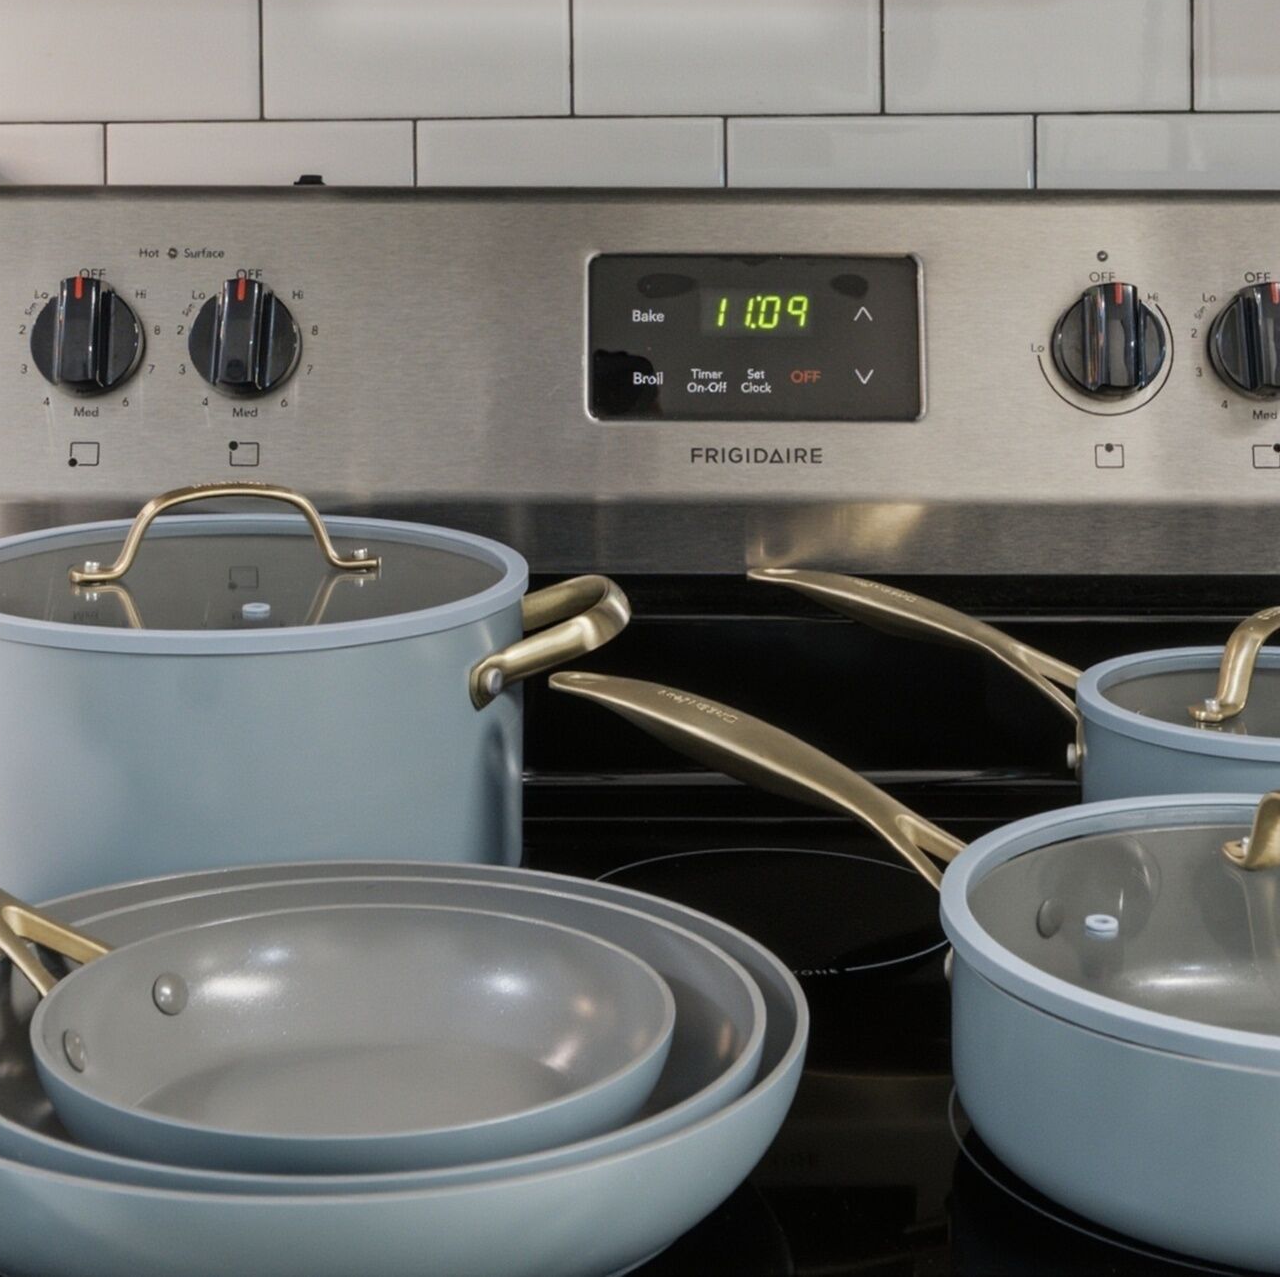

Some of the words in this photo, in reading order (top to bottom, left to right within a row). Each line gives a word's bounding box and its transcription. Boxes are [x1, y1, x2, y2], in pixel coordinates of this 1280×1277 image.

[139, 248, 159, 259] Hot
[184, 248, 226, 259] Surface
[79, 268, 106, 278] OFF
[236, 268, 263, 279] OFF
[1089, 271, 1116, 283] OFF
[1244, 271, 1271, 283] OFF
[34, 290, 48, 299] Lo
[135, 289, 147, 299] Hi
[192, 290, 206, 300] Lo
[292, 290, 304, 300] Hi
[1202, 293, 1216, 303] Lo
[632, 309, 665, 323] Bake
[717, 296, 808, 329] 11:09
[19, 325, 26, 335] 2
[154, 325, 161, 335] 8
[177, 325, 184, 335] 2
[311, 325, 319, 335] 8
[1191, 328, 1198, 338] 2
[1031, 343, 1045, 353] Lo
[21, 365, 28, 374] 3
[148, 365, 155, 374] 7
[179, 365, 186, 374] 3
[306, 365, 313, 375] 7
[690, 368, 723, 380] Timer
[746, 368, 765, 380] Set
[1195, 367, 1203, 377] 3
[632, 372, 664, 385] Broil
[790, 370, 821, 383] OFF
[740, 382, 772, 393] Clock
[43, 397, 50, 407] 4
[122, 397, 129, 407] 6
[202, 398, 209, 407] 4
[281, 398, 288, 408] 6
[1221, 400, 1228, 410] 4
[73, 407, 100, 418] Med
[232, 407, 259, 418] Med
[1252, 410, 1278, 420] Med
[690, 447, 823, 464] FRIGIDAIRE
